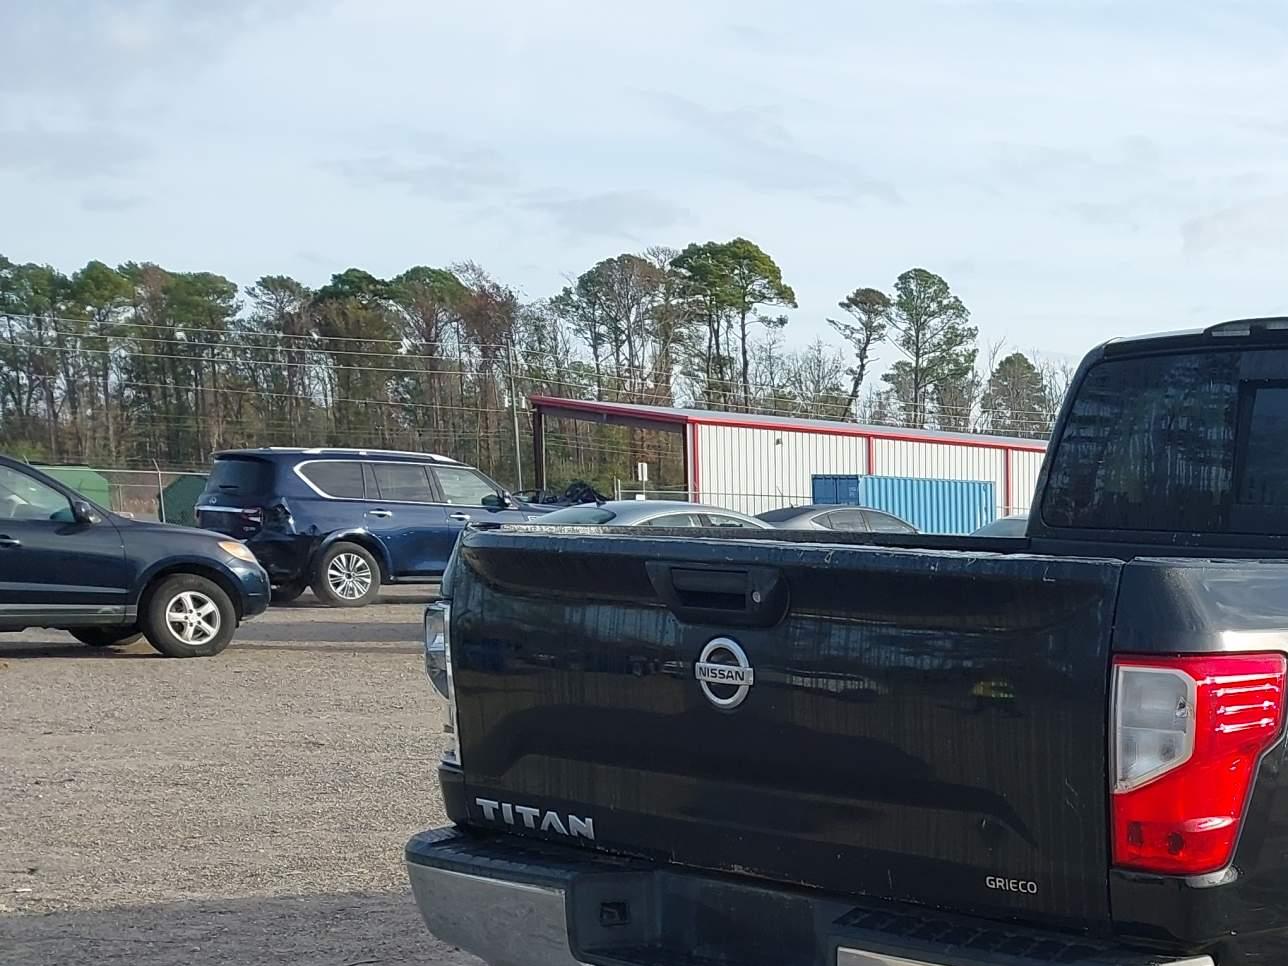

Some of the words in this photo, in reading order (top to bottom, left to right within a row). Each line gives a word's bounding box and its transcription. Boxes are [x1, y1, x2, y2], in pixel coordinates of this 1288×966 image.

[699, 667, 745, 681] NISSAN
[476, 797, 595, 840] TITAN
[985, 876, 1038, 894] GRIECO
